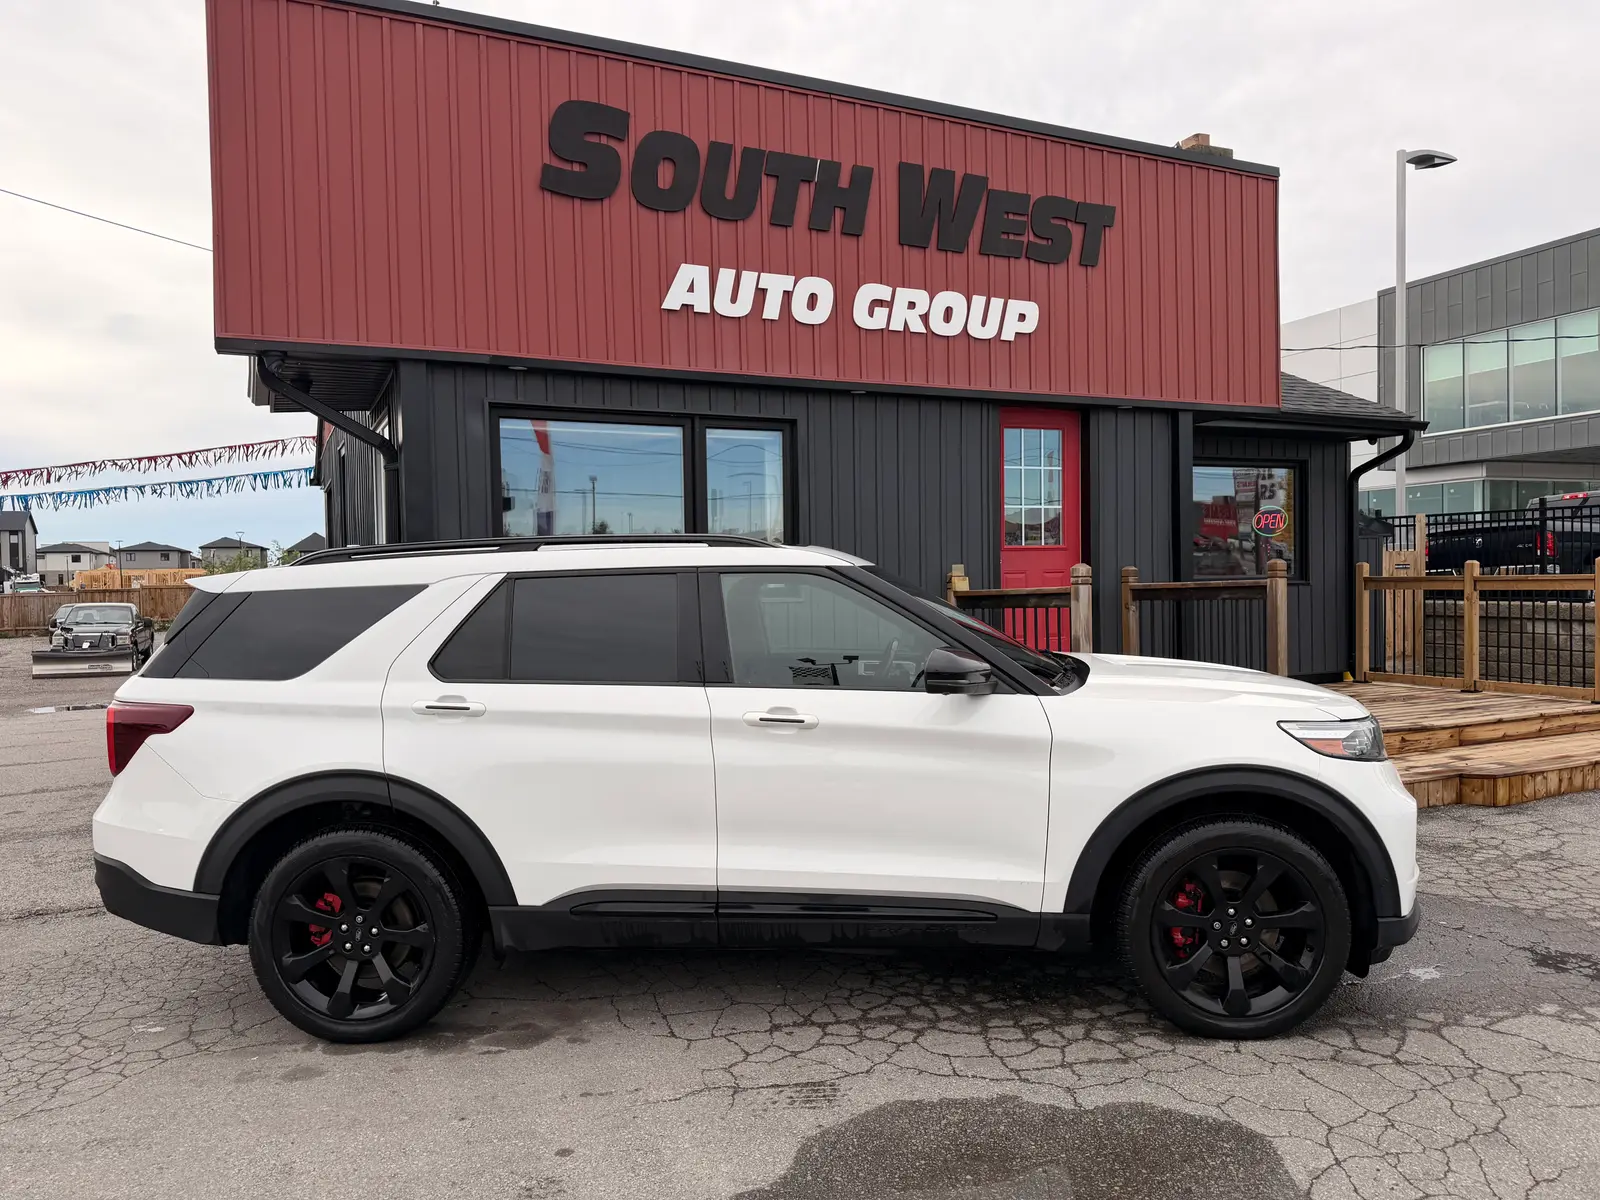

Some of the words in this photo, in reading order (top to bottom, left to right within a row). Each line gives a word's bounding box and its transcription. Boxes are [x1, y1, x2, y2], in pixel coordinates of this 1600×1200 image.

[540, 100, 873, 237] SOUTH
[899, 161, 1116, 266] WEST
[661, 263, 834, 326] AUTO
[852, 283, 1040, 342] GROUP
[1254, 514, 1285, 529] OPEN
